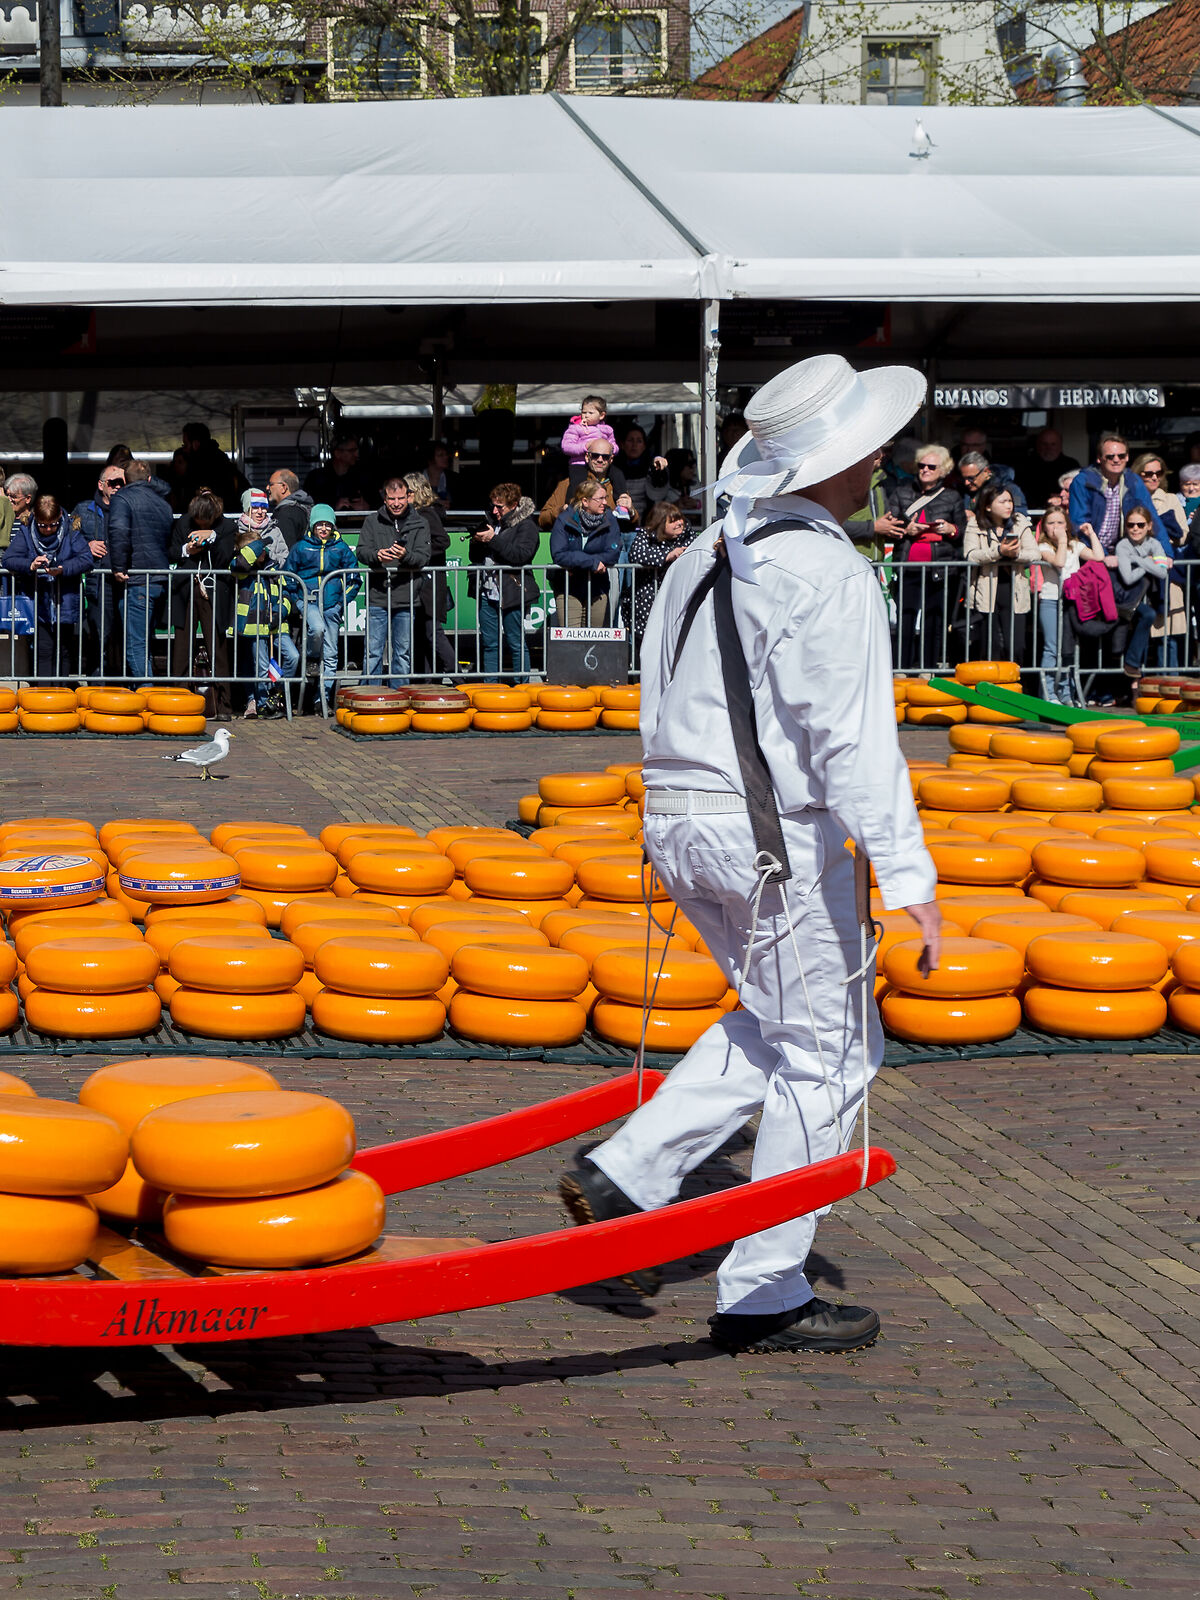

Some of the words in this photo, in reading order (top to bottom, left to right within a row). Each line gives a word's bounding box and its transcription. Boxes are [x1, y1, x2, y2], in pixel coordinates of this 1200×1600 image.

[934, 388, 1009, 406] RMANOS
[1058, 388, 1159, 406] HERMANOS
[566, 630, 611, 639] ALKMAAR
[584, 644, 599, 671] 6
[99, 1298, 268, 1338] Alkmaar
